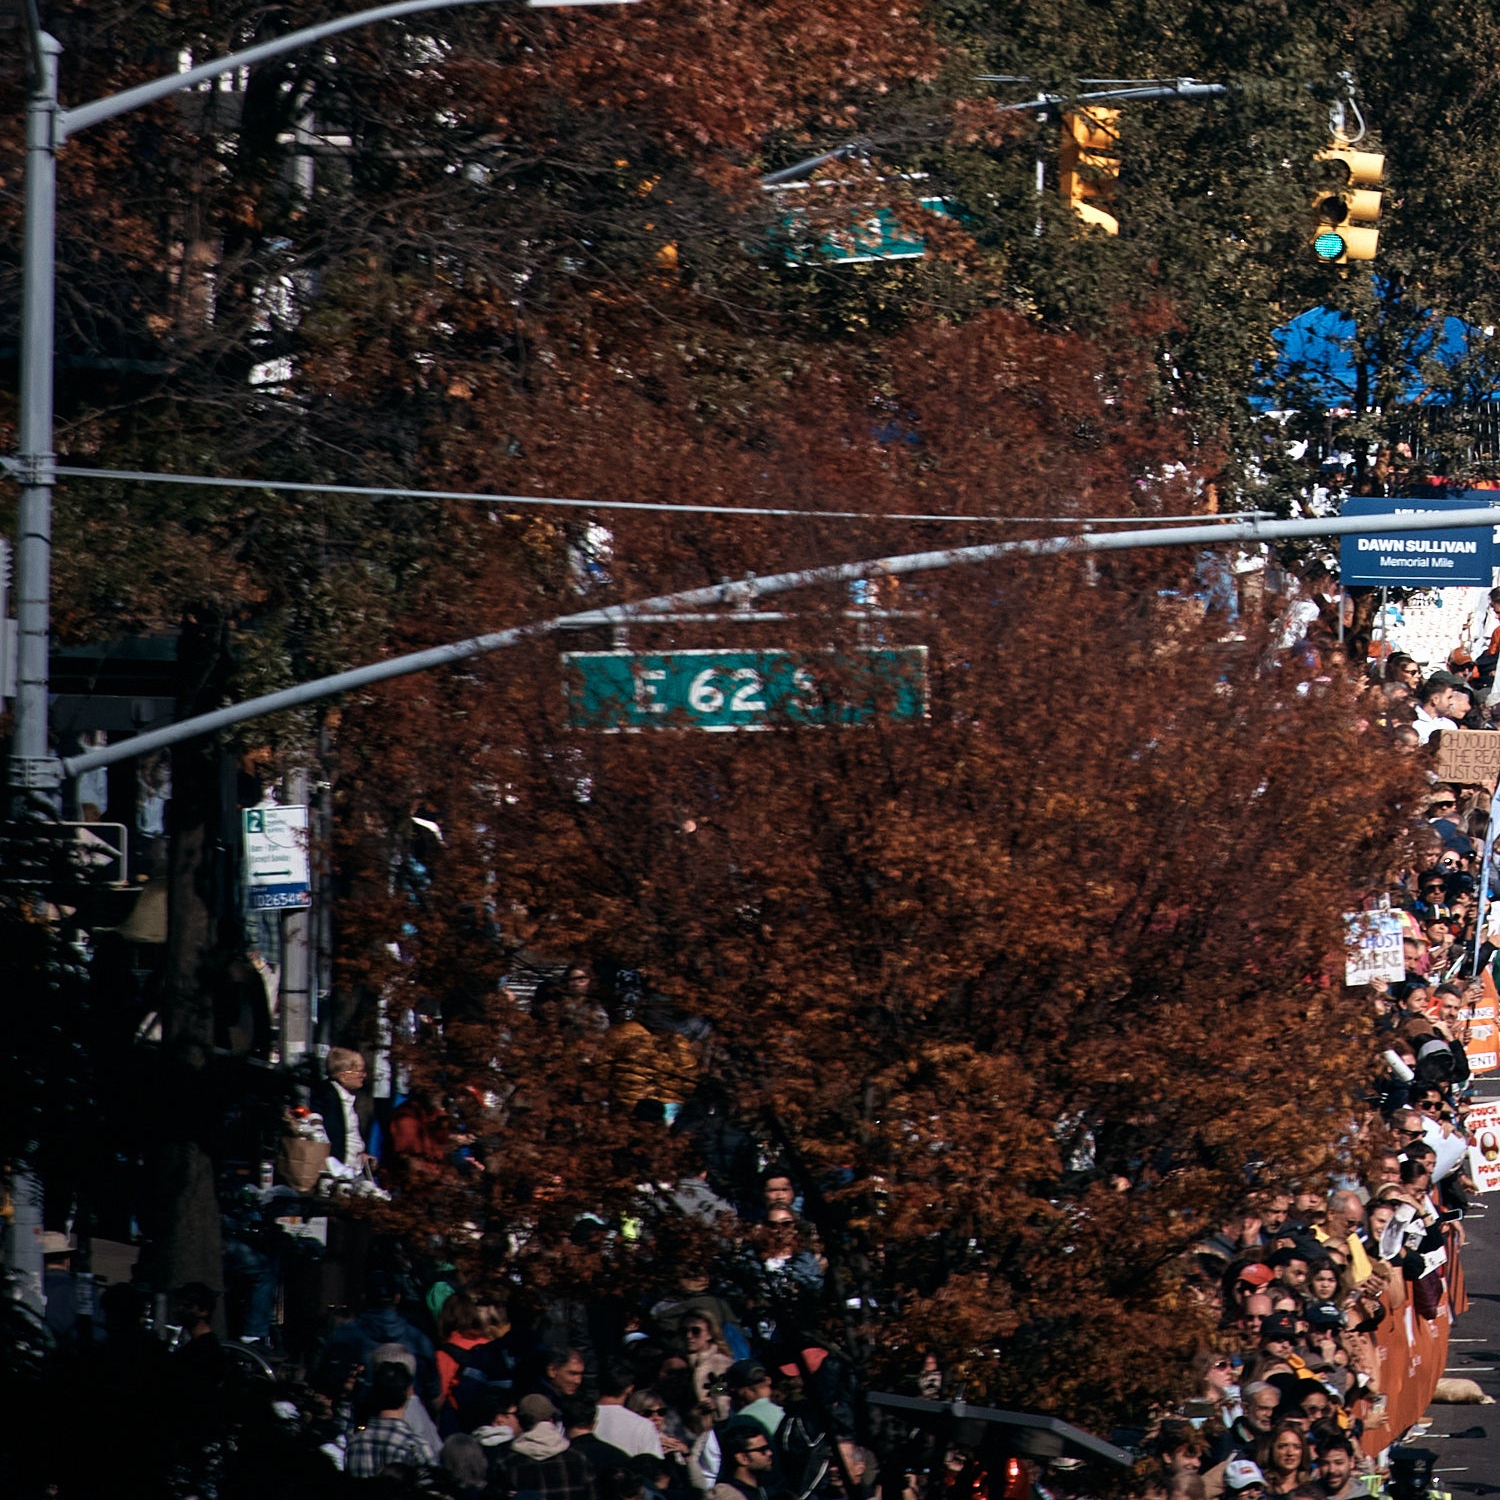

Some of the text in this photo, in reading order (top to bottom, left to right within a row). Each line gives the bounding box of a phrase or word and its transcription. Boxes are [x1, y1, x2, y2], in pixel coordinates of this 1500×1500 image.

[1406, 539, 1478, 554] SULLIVAN
[1379, 555, 1455, 569] Memorial Mile
[634, 670, 667, 713] E
[687, 666, 768, 714] 62
[1461, 735, 1487, 749] YOU
[1449, 749, 1471, 761] THE
[1440, 764, 1498, 780] JUST STAR
[1469, 1054, 1496, 1067] ENT!
[1470, 1106, 1497, 1117] TOUCH
[1468, 1117, 1488, 1128] HERE
